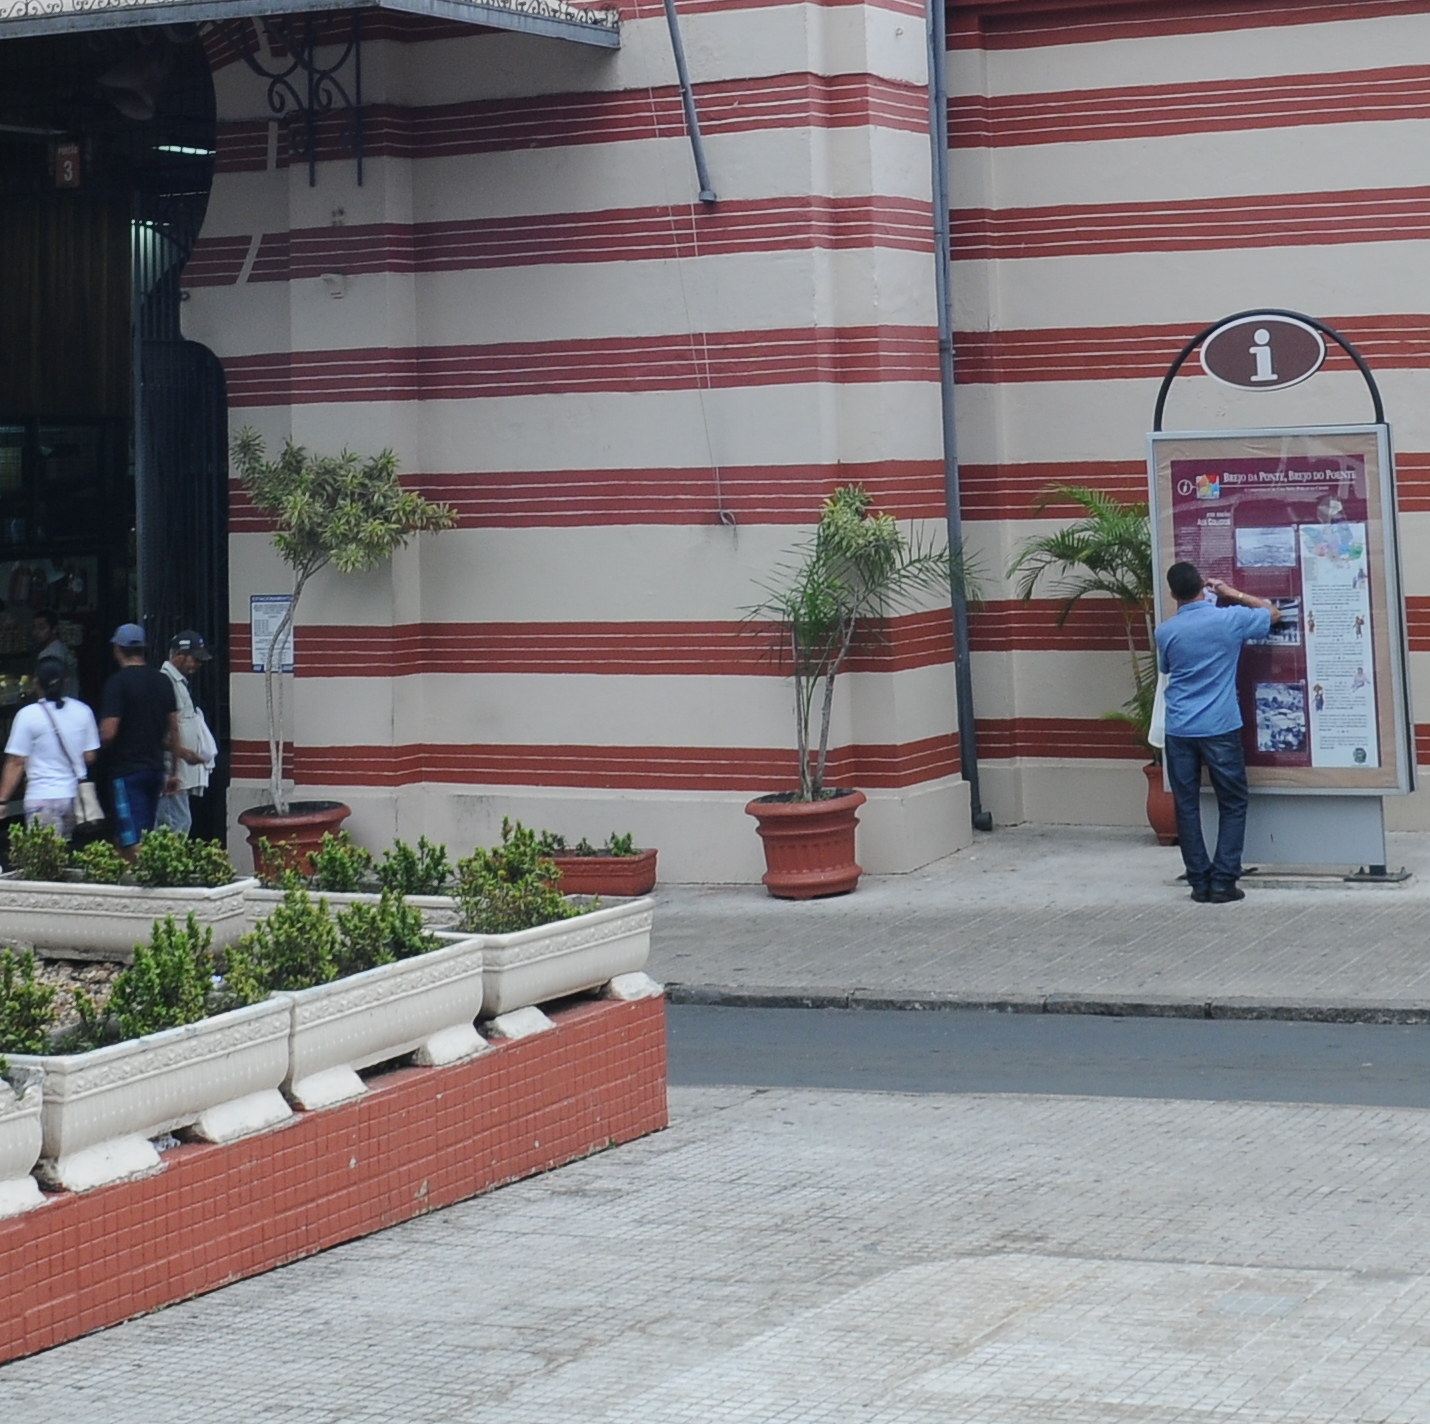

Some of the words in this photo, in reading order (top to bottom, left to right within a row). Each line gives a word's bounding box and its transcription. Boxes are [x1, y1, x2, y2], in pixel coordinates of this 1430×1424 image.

[63, 160, 73, 181] 3
[1249, 328, 1278, 382] i
[1223, 472, 1247, 485] BREJO
[1288, 470, 1312, 483] BREJO
